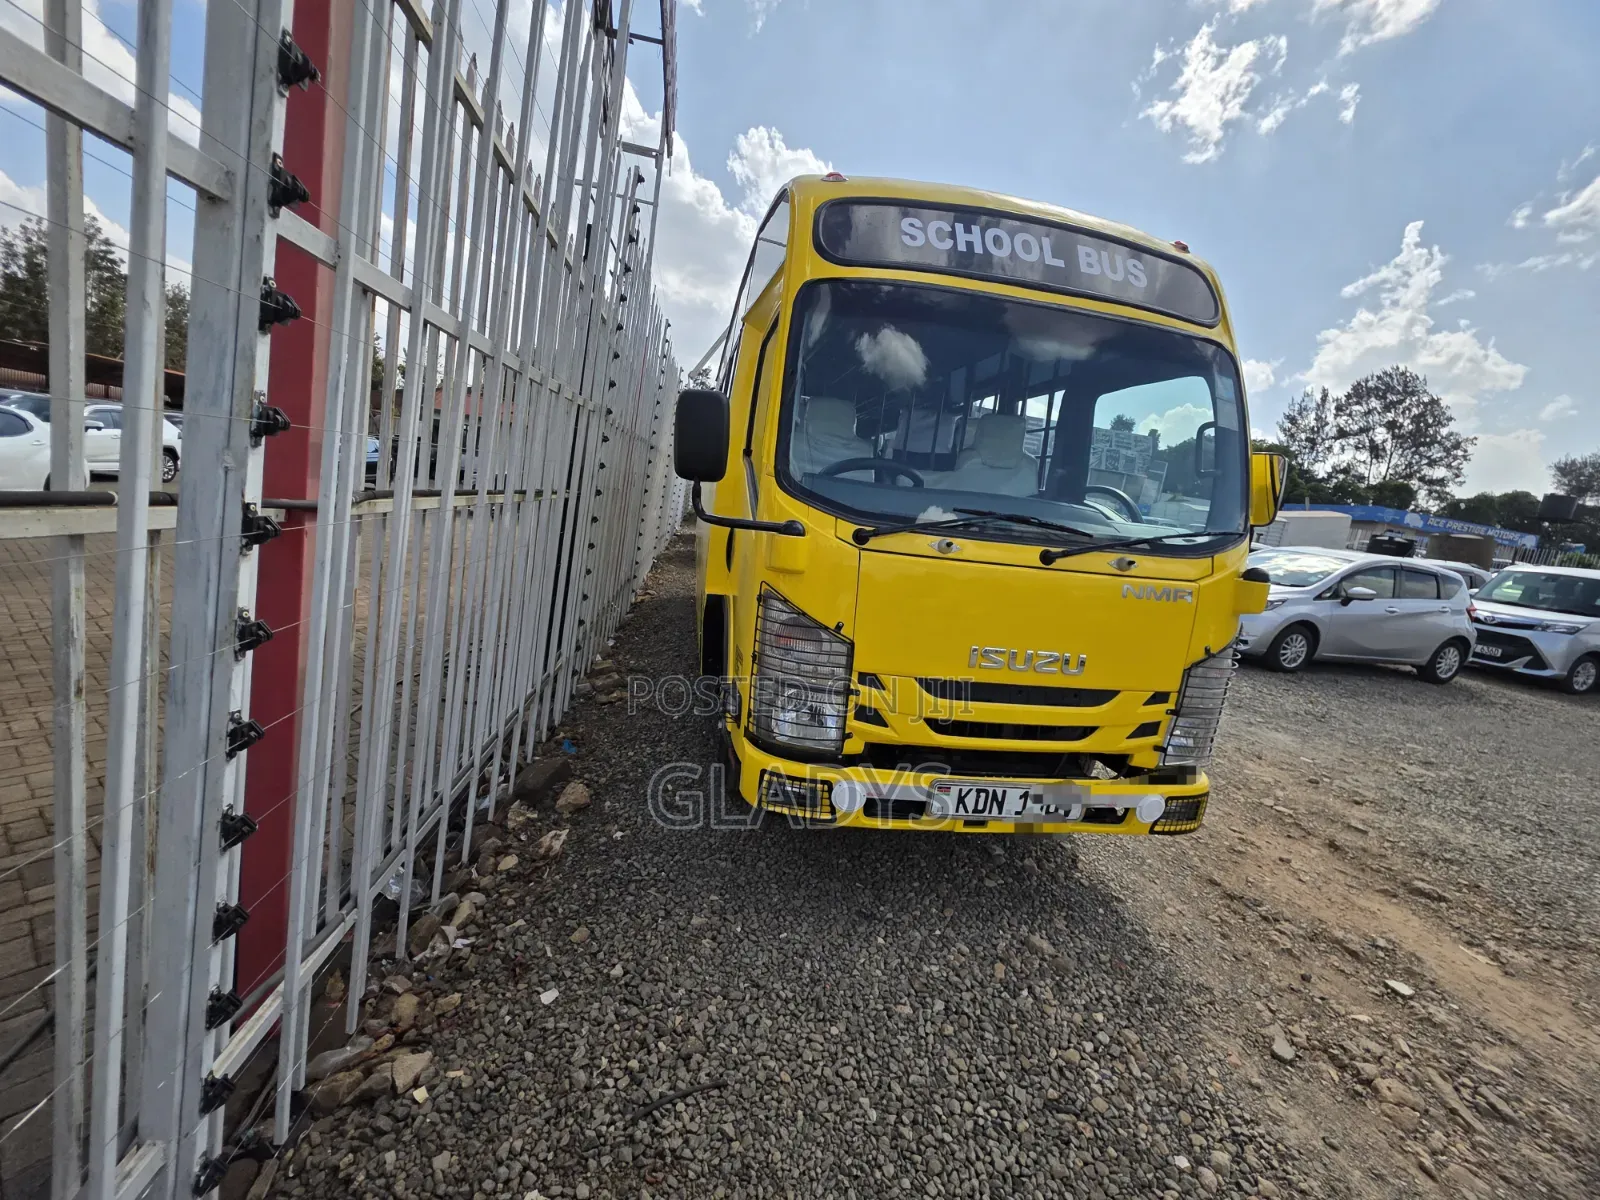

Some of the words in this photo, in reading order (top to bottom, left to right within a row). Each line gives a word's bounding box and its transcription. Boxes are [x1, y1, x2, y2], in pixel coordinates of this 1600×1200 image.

[900, 217, 1066, 268] SCHOOL
[1076, 244, 1148, 288] BUS
[1427, 517, 1445, 528] ACE
[1446, 521, 1486, 535] PRESTIGE
[1486, 528, 1520, 541] MOTORS
[1121, 583, 1194, 604] NMR
[968, 645, 1087, 677] ISUZU
[954, 787, 1007, 816] KDN
